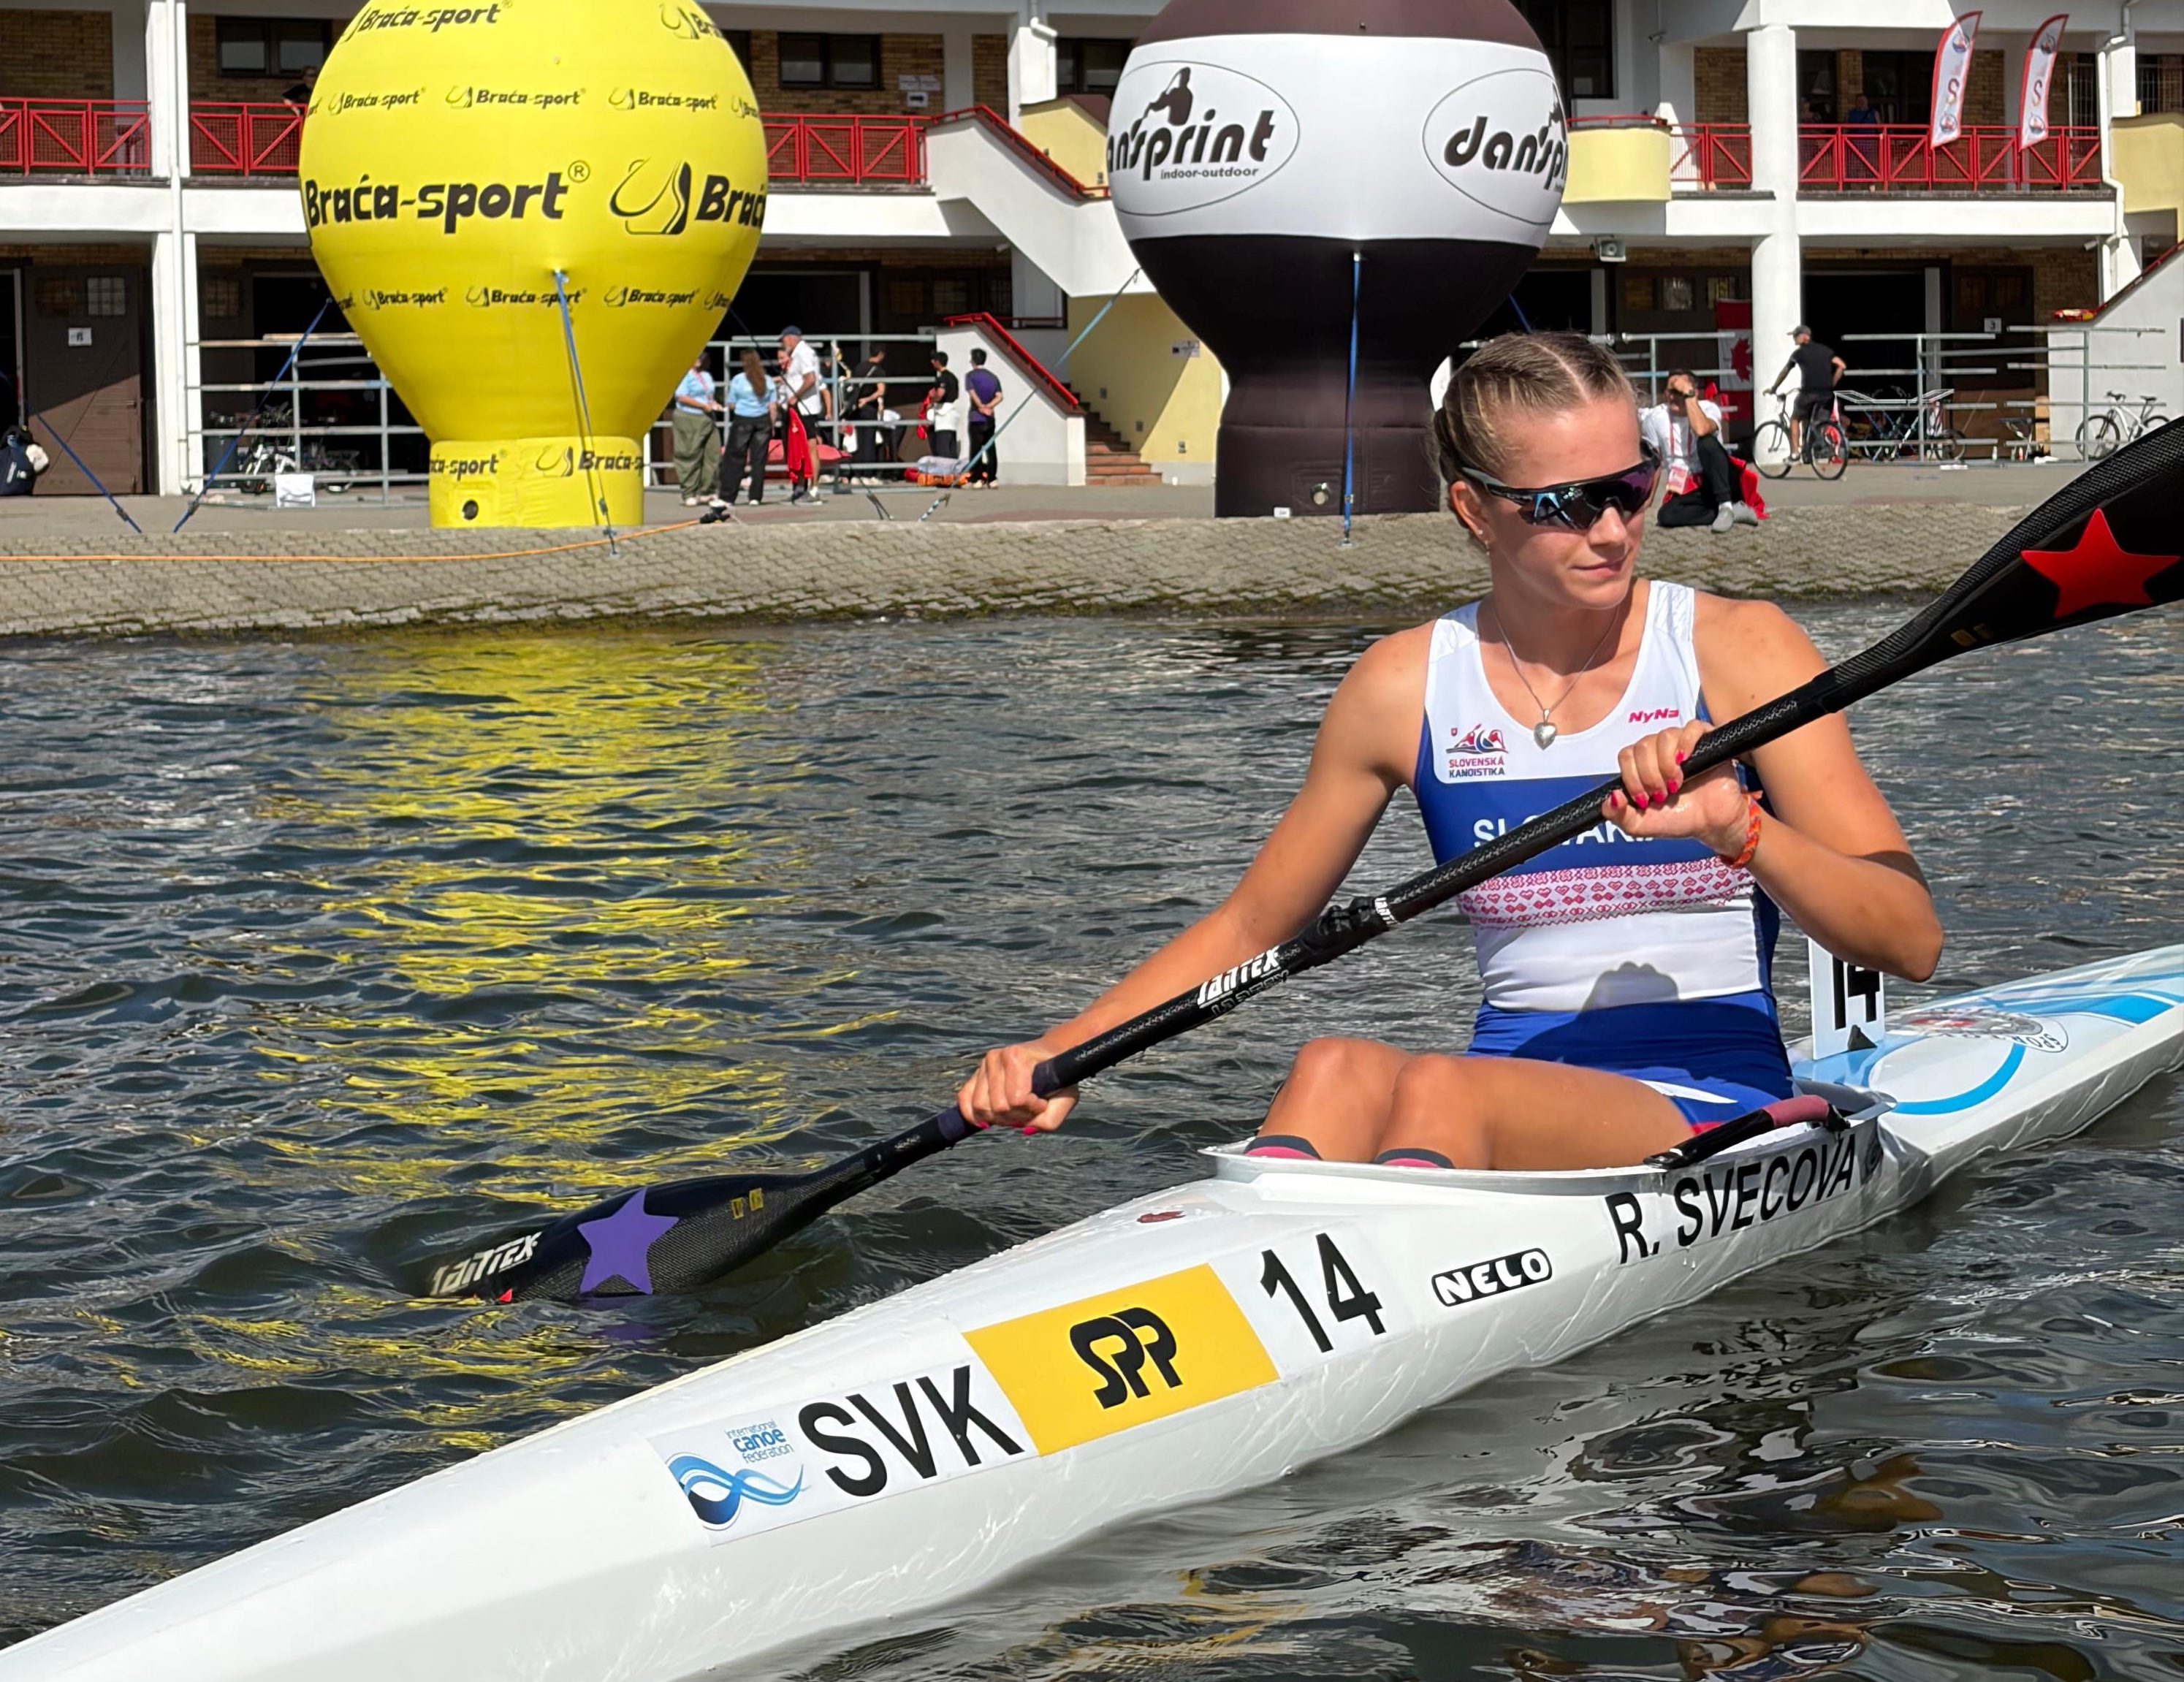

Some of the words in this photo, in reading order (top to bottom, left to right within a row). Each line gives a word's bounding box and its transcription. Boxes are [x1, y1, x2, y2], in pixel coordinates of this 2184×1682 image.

[1160, 167, 1259, 180] indoor-outdoor
[1449, 767, 1505, 778] KANOISTIKA
[1605, 1191, 1660, 1263] R.
[1673, 1133, 1857, 1247] SVECOVA
[1259, 1233, 1387, 1353] 14
[1433, 1249, 1552, 1304] NELO
[733, 1428, 787, 1453] canoe
[798, 1364, 1024, 1497] SVK
[742, 1443, 794, 1464] federation
